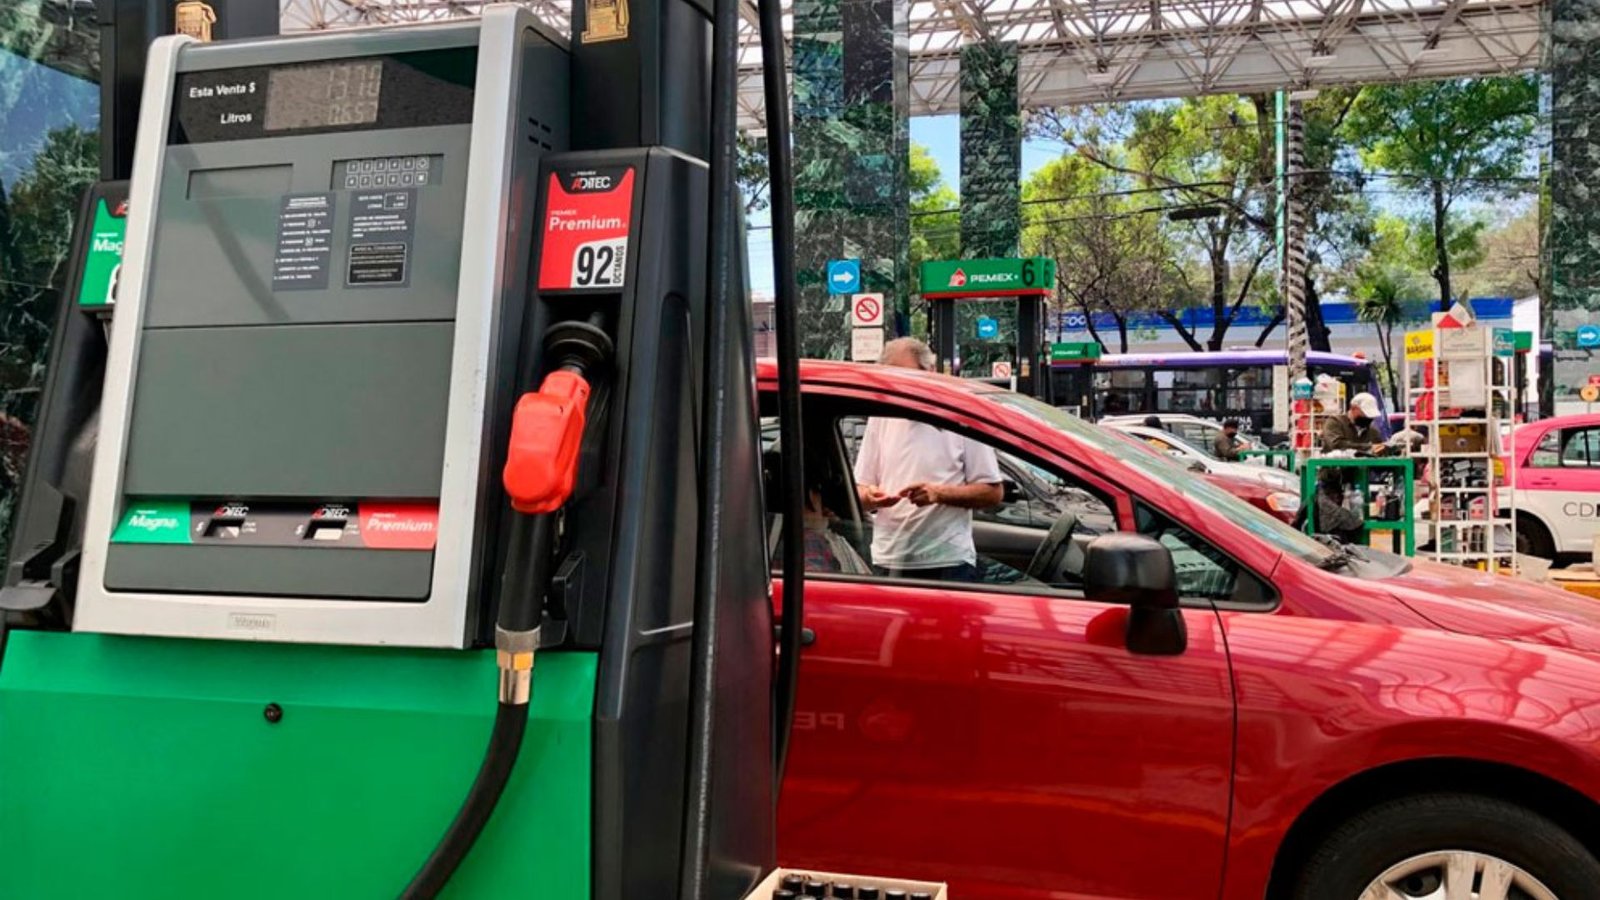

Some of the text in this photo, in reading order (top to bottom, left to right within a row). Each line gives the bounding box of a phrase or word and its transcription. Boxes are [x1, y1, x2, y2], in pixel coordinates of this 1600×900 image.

[189, 82, 256, 98] Esta Venta $
[220, 113, 252, 125] Litros
[549, 215, 621, 232] Premium
[576, 245, 614, 286] 92
[613, 245, 625, 284] OCTANOS
[970, 259, 1034, 287] PEMEX 6
[1043, 261, 1051, 288] 6
[1562, 501, 1600, 517] CD
[129, 514, 177, 531] Magna
[196, 521, 204, 532] $
[295, 524, 303, 535] $
[367, 517, 434, 532] Premium
